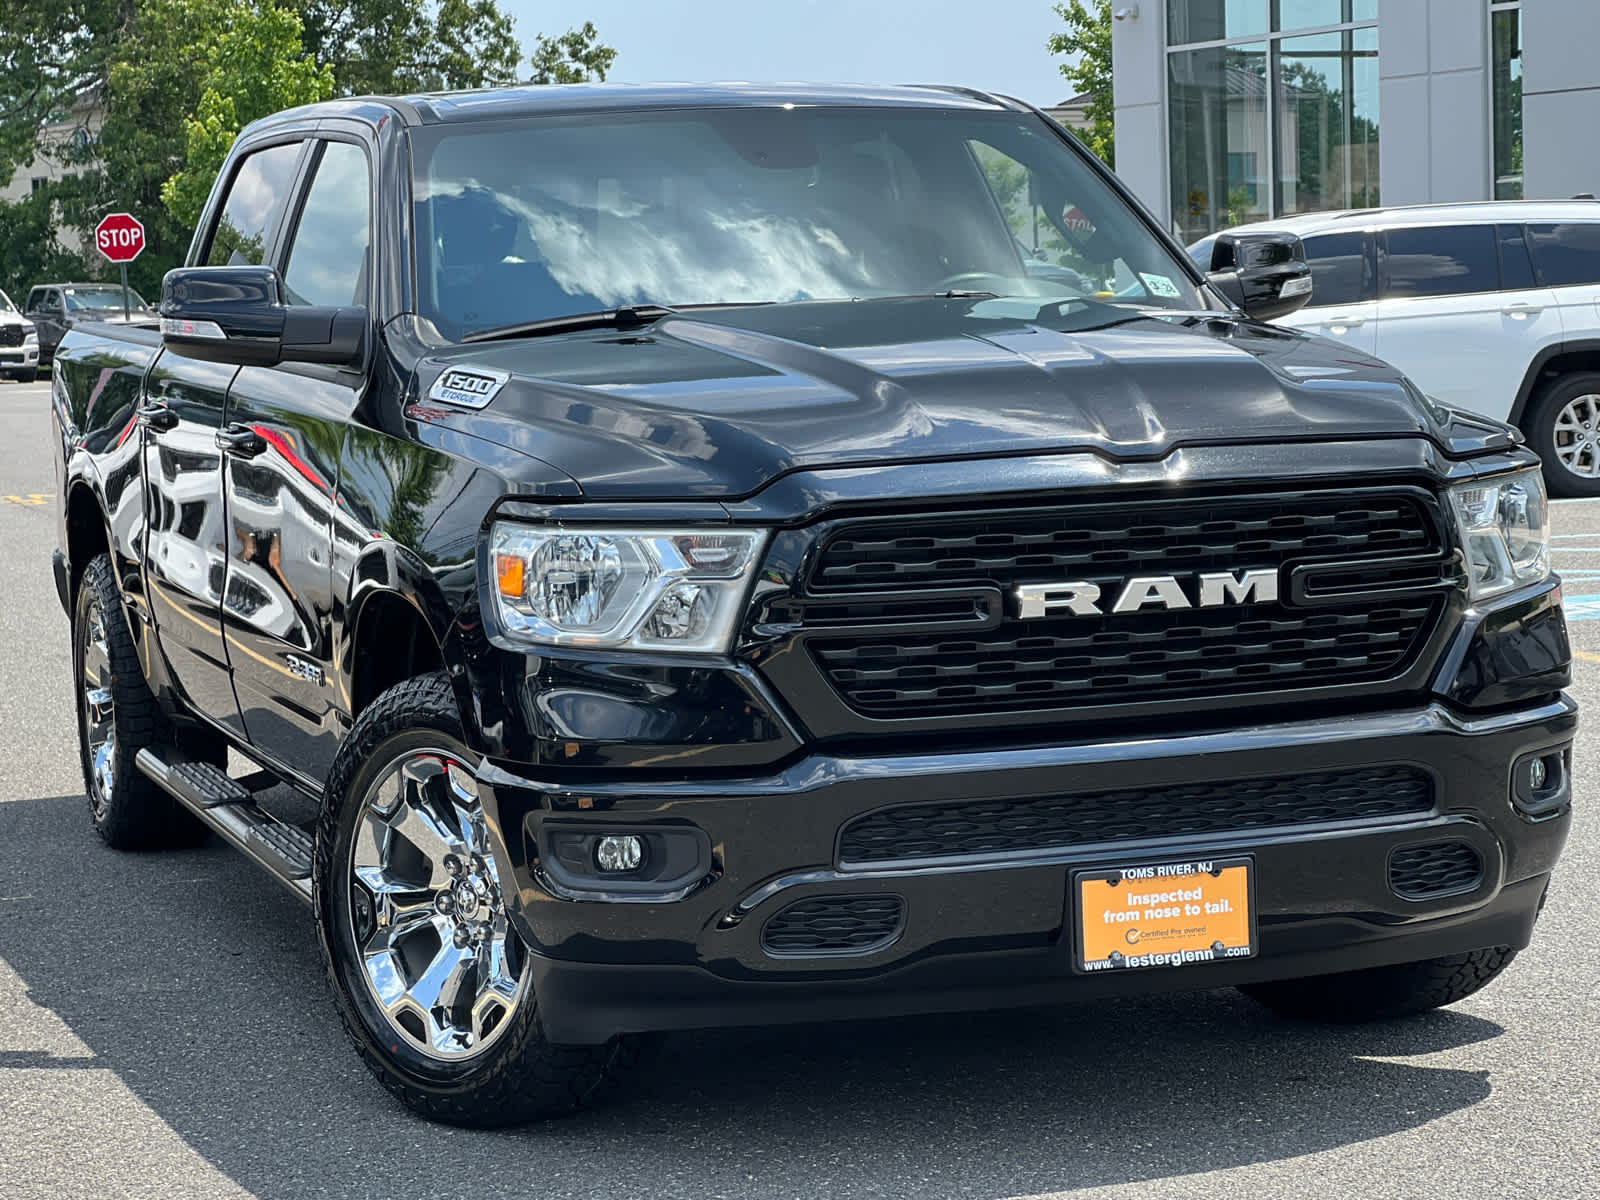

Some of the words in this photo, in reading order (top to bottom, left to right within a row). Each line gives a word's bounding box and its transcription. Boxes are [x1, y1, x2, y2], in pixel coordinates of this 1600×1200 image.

[99, 228, 141, 247] STOP
[445, 373, 495, 393] 1500
[1015, 568, 1279, 619] RAM
[1120, 867, 1155, 880] TOMS
[1157, 863, 1195, 876] RIVER,
[1198, 861, 1213, 873] NJ
[1128, 887, 1202, 907] Inspected
[1103, 910, 1140, 924] from
[1144, 905, 1180, 919] nose
[1185, 903, 1200, 915] to
[1204, 899, 1233, 914] tail.
[1140, 928, 1169, 938] Certified
[1084, 959, 1114, 971] www.
[1125, 949, 1214, 968] lesterglenn
[1224, 946, 1250, 957] .com
